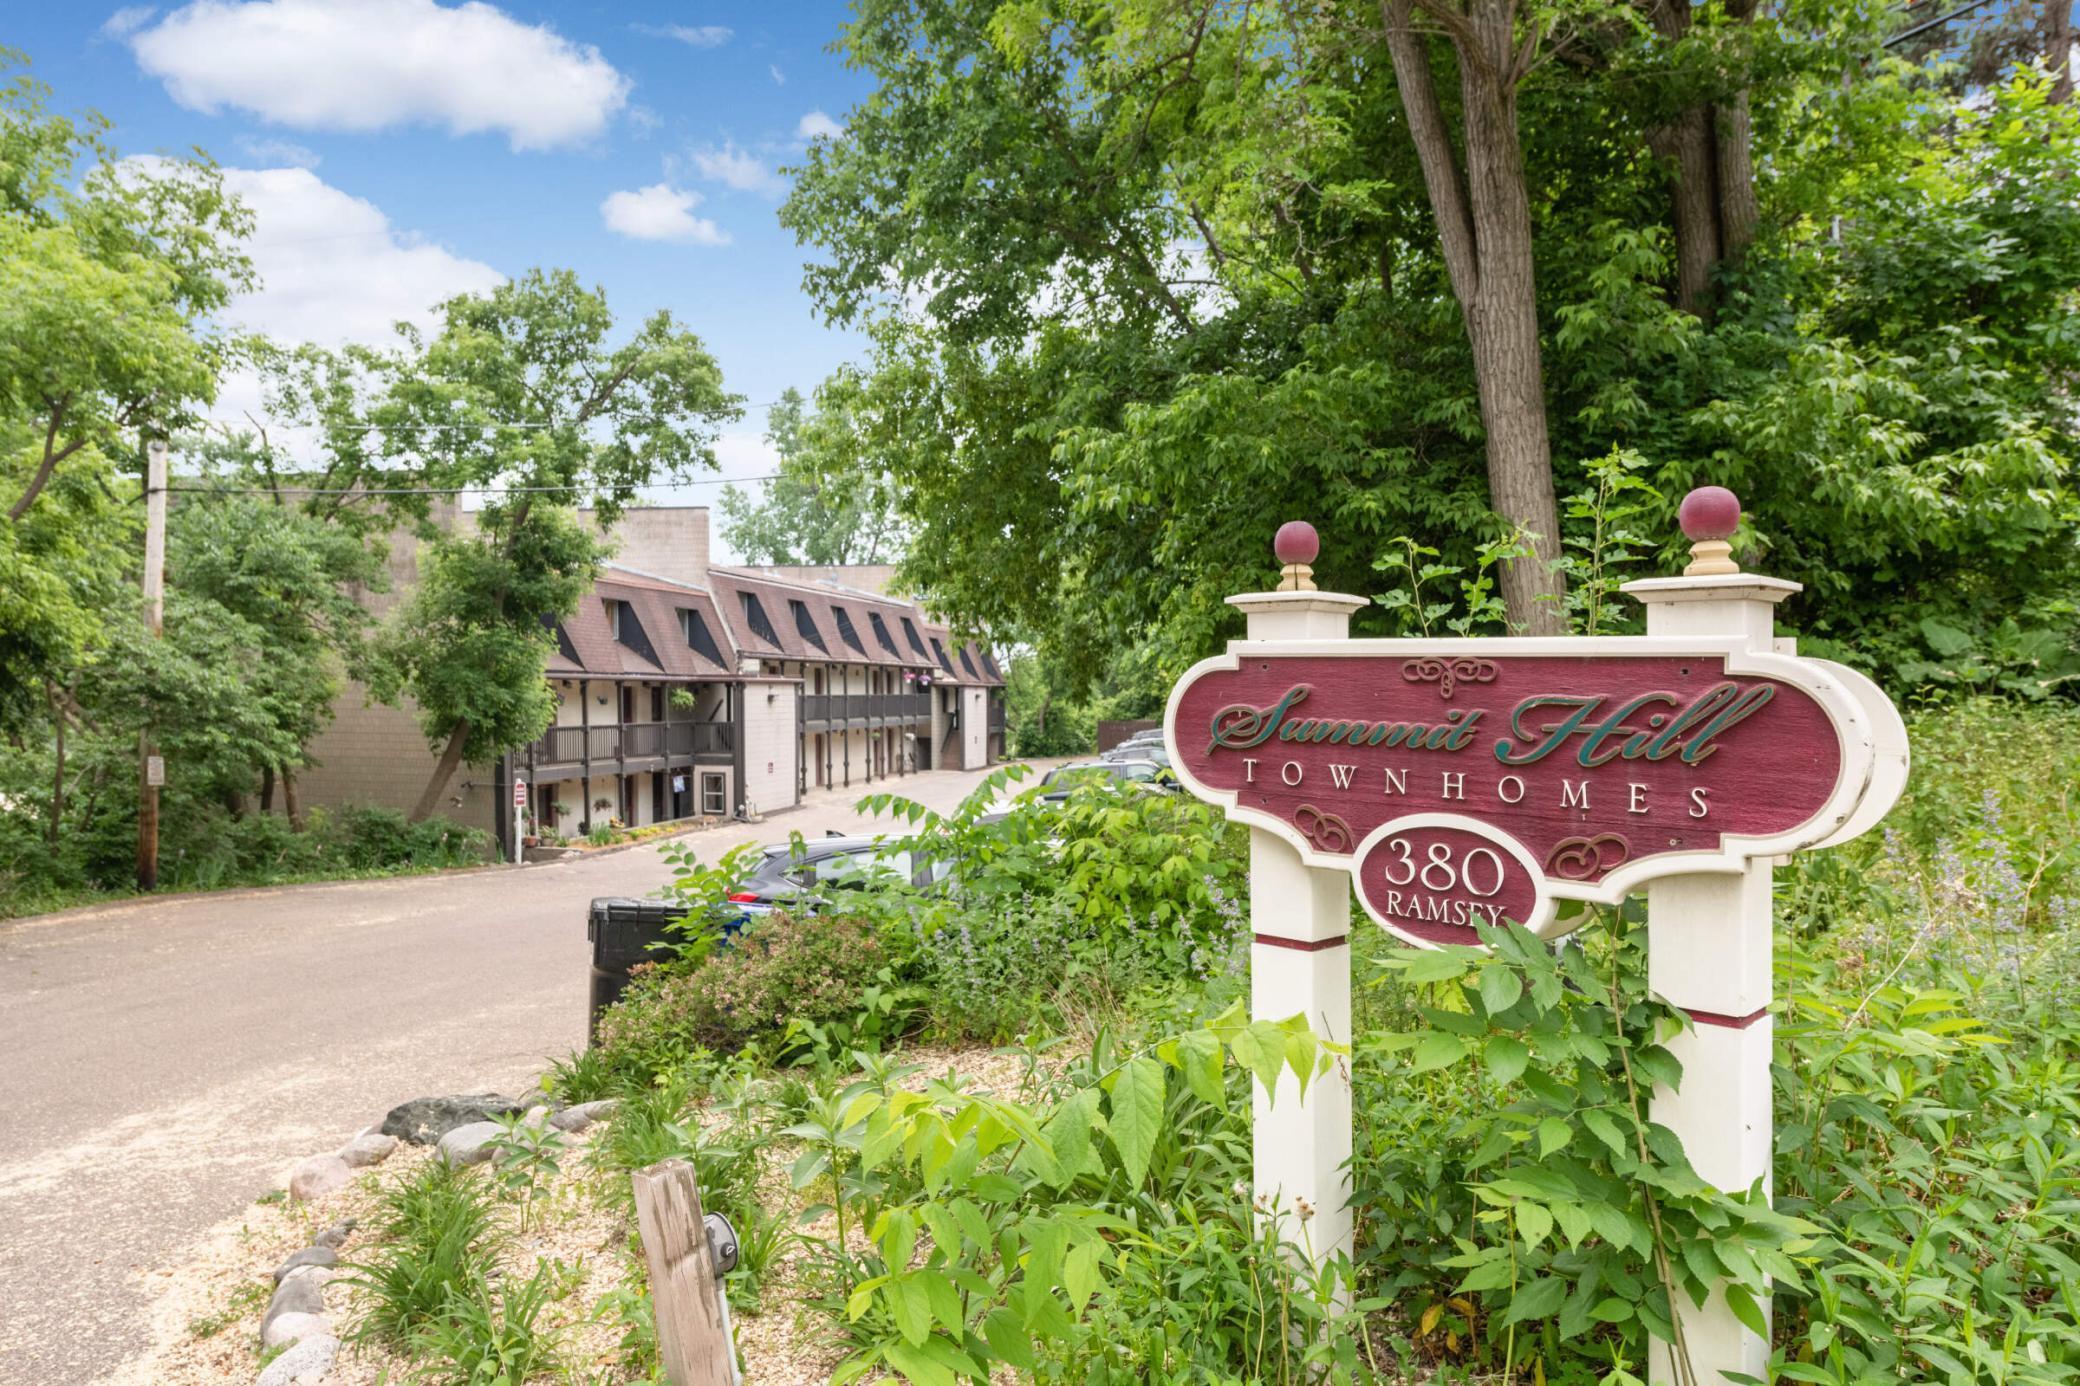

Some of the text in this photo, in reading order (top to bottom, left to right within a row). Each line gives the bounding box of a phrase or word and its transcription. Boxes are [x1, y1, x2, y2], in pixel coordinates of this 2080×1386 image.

[1204, 681, 1776, 767] Summit Hill
[1242, 758, 1710, 818] TOWNHOMES
[1385, 838, 1505, 897] 380
